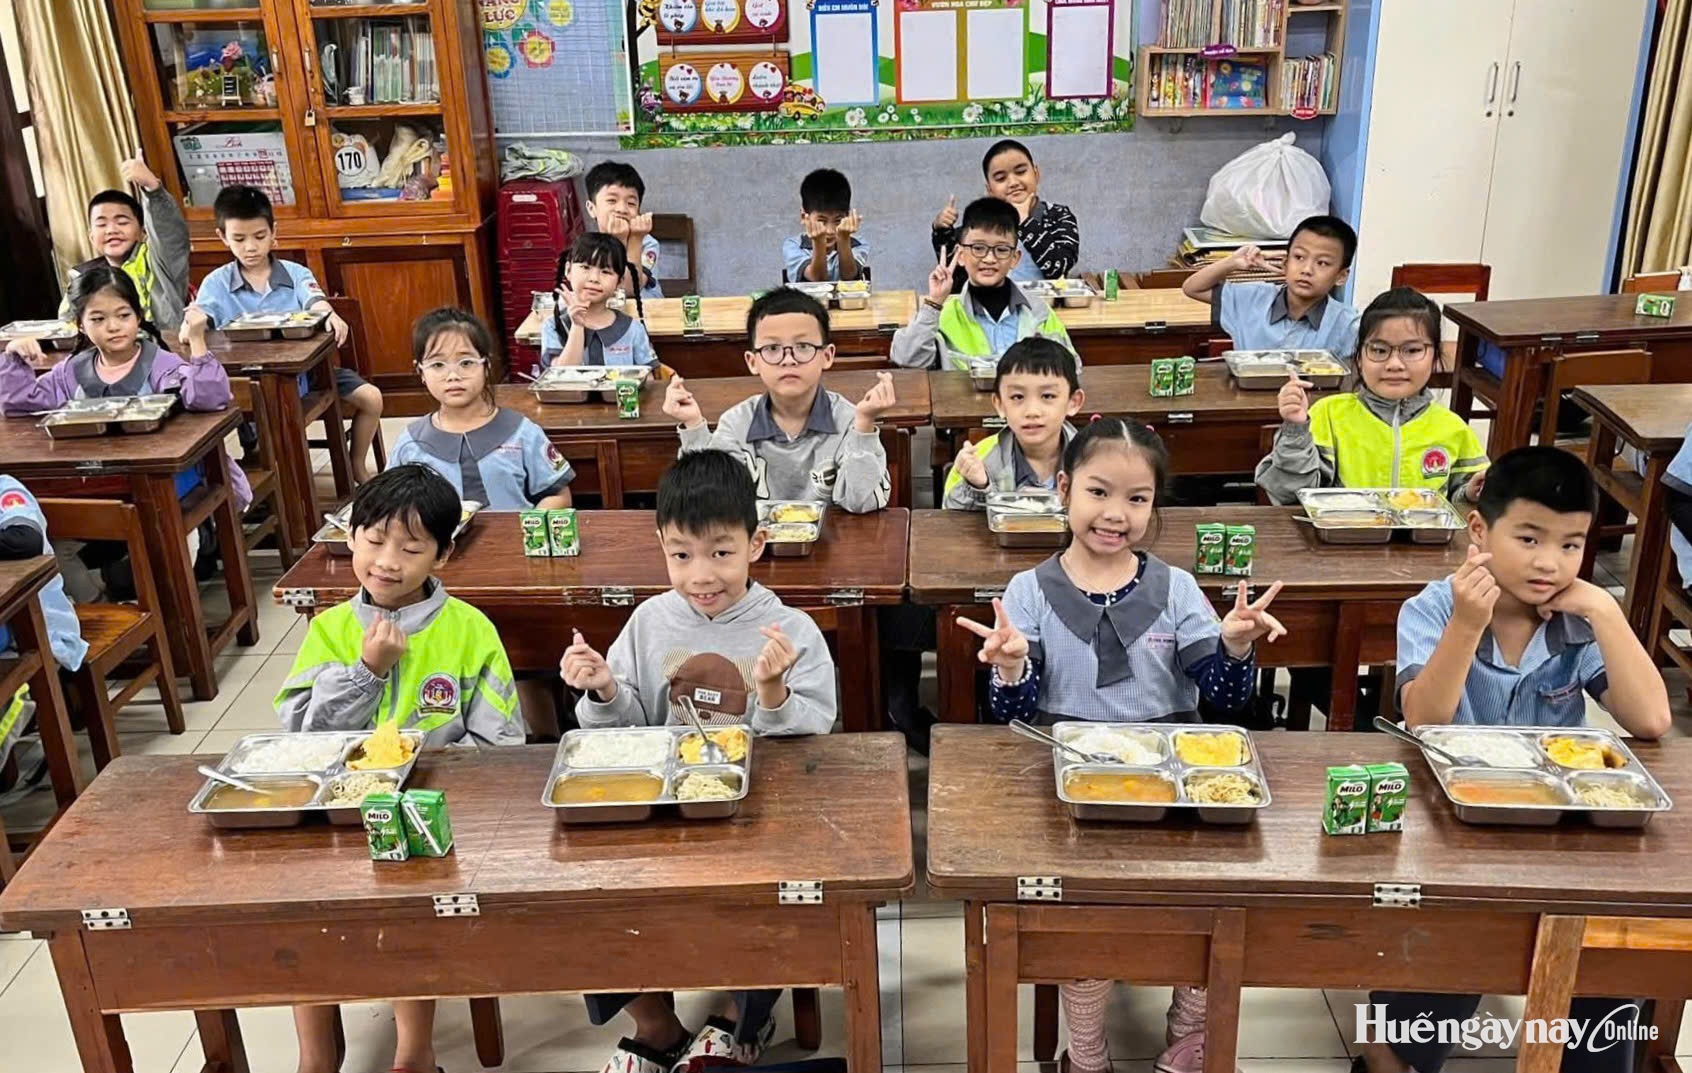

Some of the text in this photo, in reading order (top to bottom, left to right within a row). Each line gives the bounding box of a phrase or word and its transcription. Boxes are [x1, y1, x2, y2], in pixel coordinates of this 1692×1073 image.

[338, 152, 362, 171] 170
[1339, 785, 1364, 793] MILO
[1378, 783, 1402, 791] MILO
[367, 812, 390, 820] MILO
